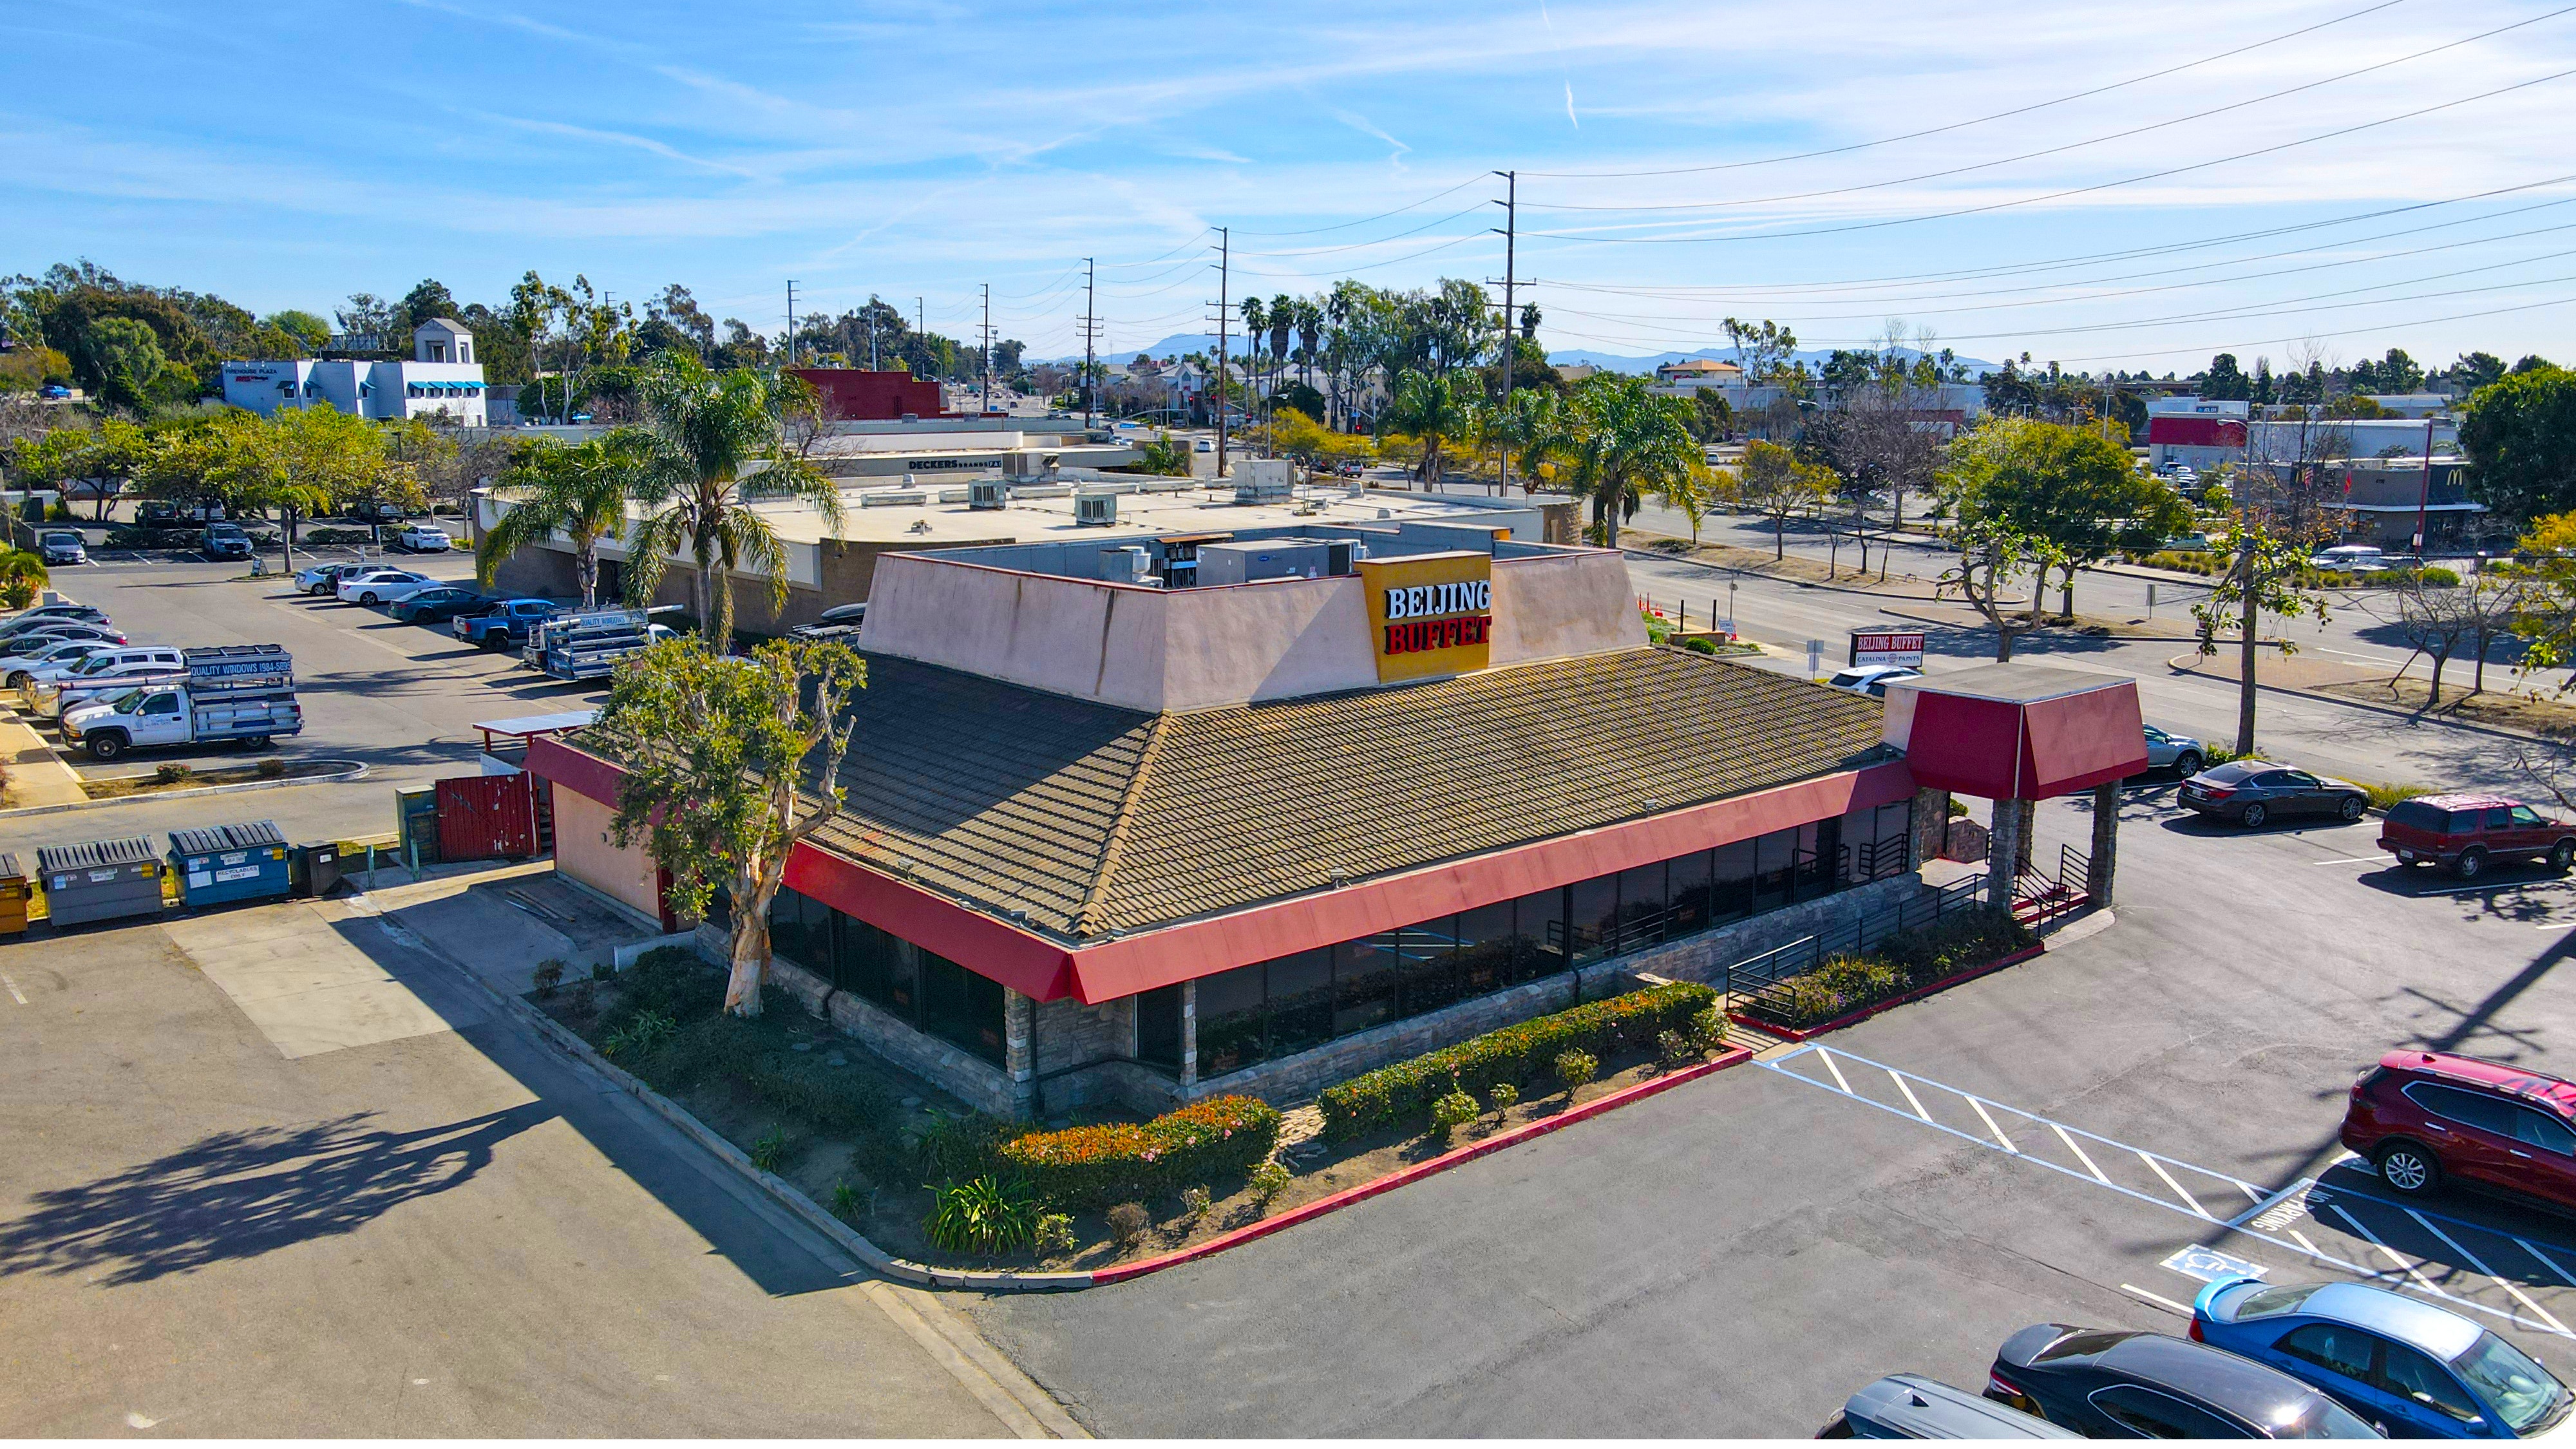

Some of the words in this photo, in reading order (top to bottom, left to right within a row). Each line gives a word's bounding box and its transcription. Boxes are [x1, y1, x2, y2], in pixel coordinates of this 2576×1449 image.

[909, 460, 958, 469] DECKERS
[1385, 580, 1493, 620] BEIJING
[1385, 616, 1492, 655] BUFFET
[1857, 636, 1889, 650] BEIJING
[1891, 635, 1923, 650] BUFFET
[191, 665, 220, 676] QUALITY
[222, 663, 258, 674] WINDOWS
[218, 866, 258, 876] RECYCLABLES
[2298, 1188, 2334, 1203] NO
[2250, 1198, 2316, 1231] PARKING
